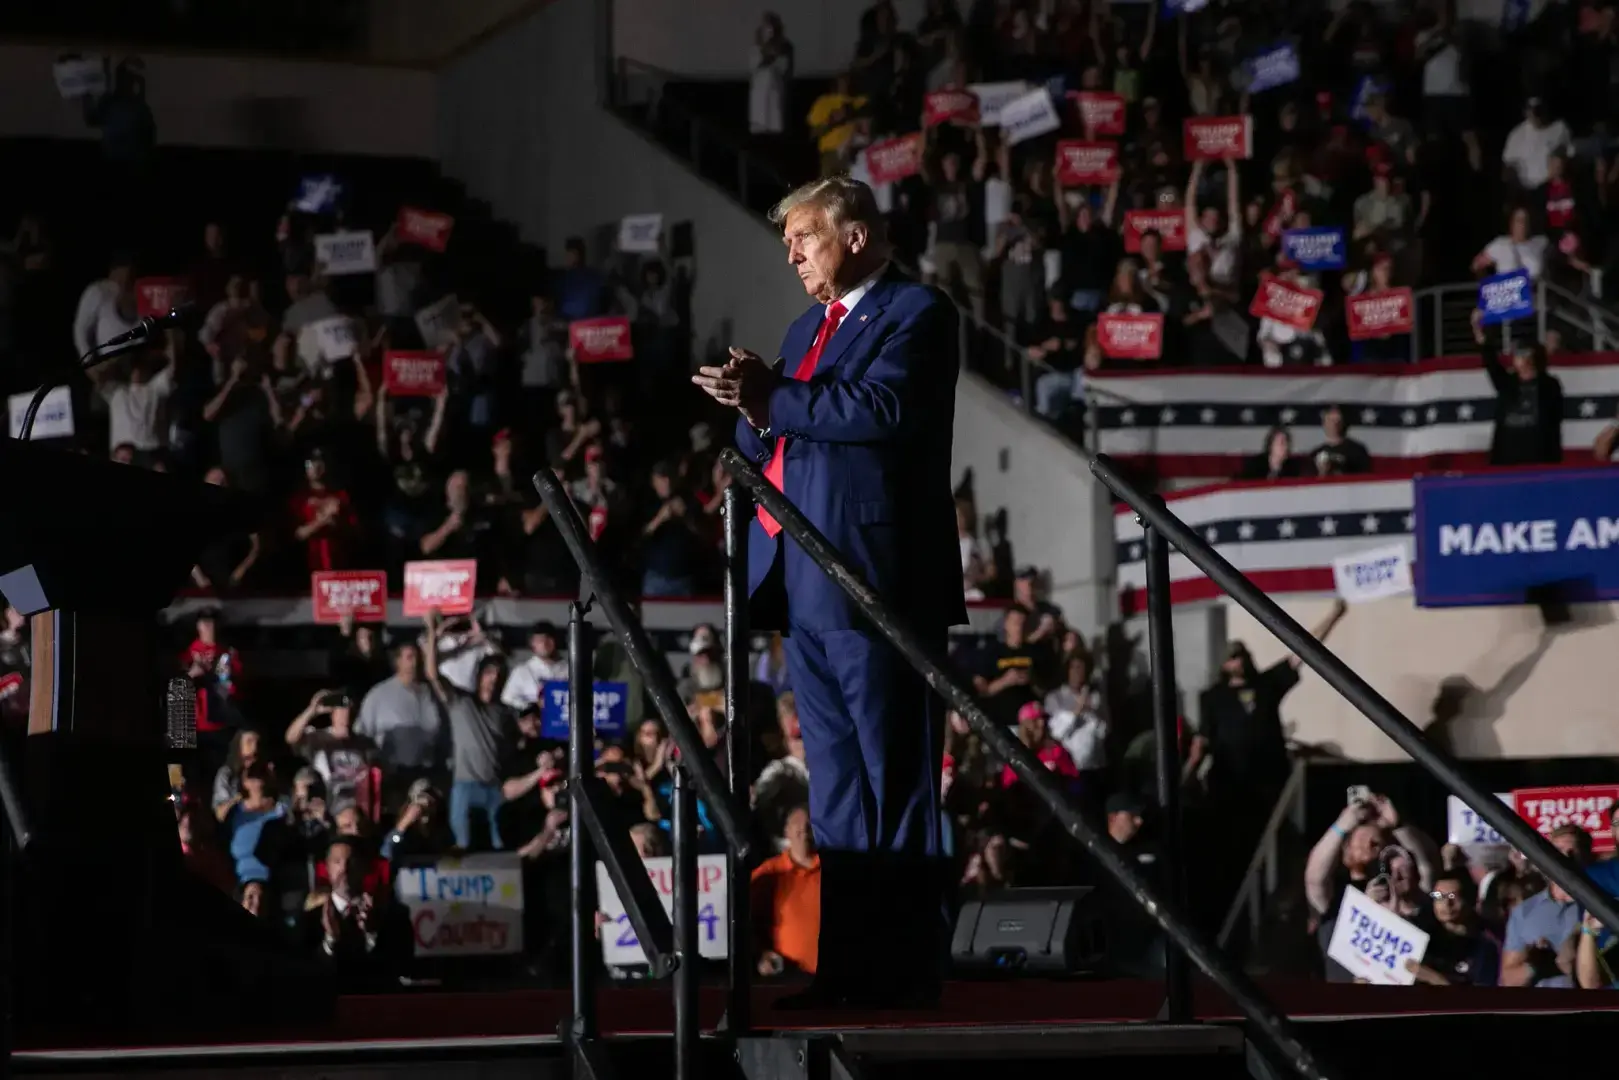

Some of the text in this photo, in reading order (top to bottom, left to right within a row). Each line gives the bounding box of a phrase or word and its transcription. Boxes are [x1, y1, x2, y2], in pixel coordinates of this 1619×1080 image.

[1439, 519, 1557, 556] MAKE
[319, 579, 379, 598] TRUMP
[1522, 796, 1614, 817] TRUMP
[1350, 905, 1413, 954] TRUMP
[1349, 930, 1396, 969] 2024
